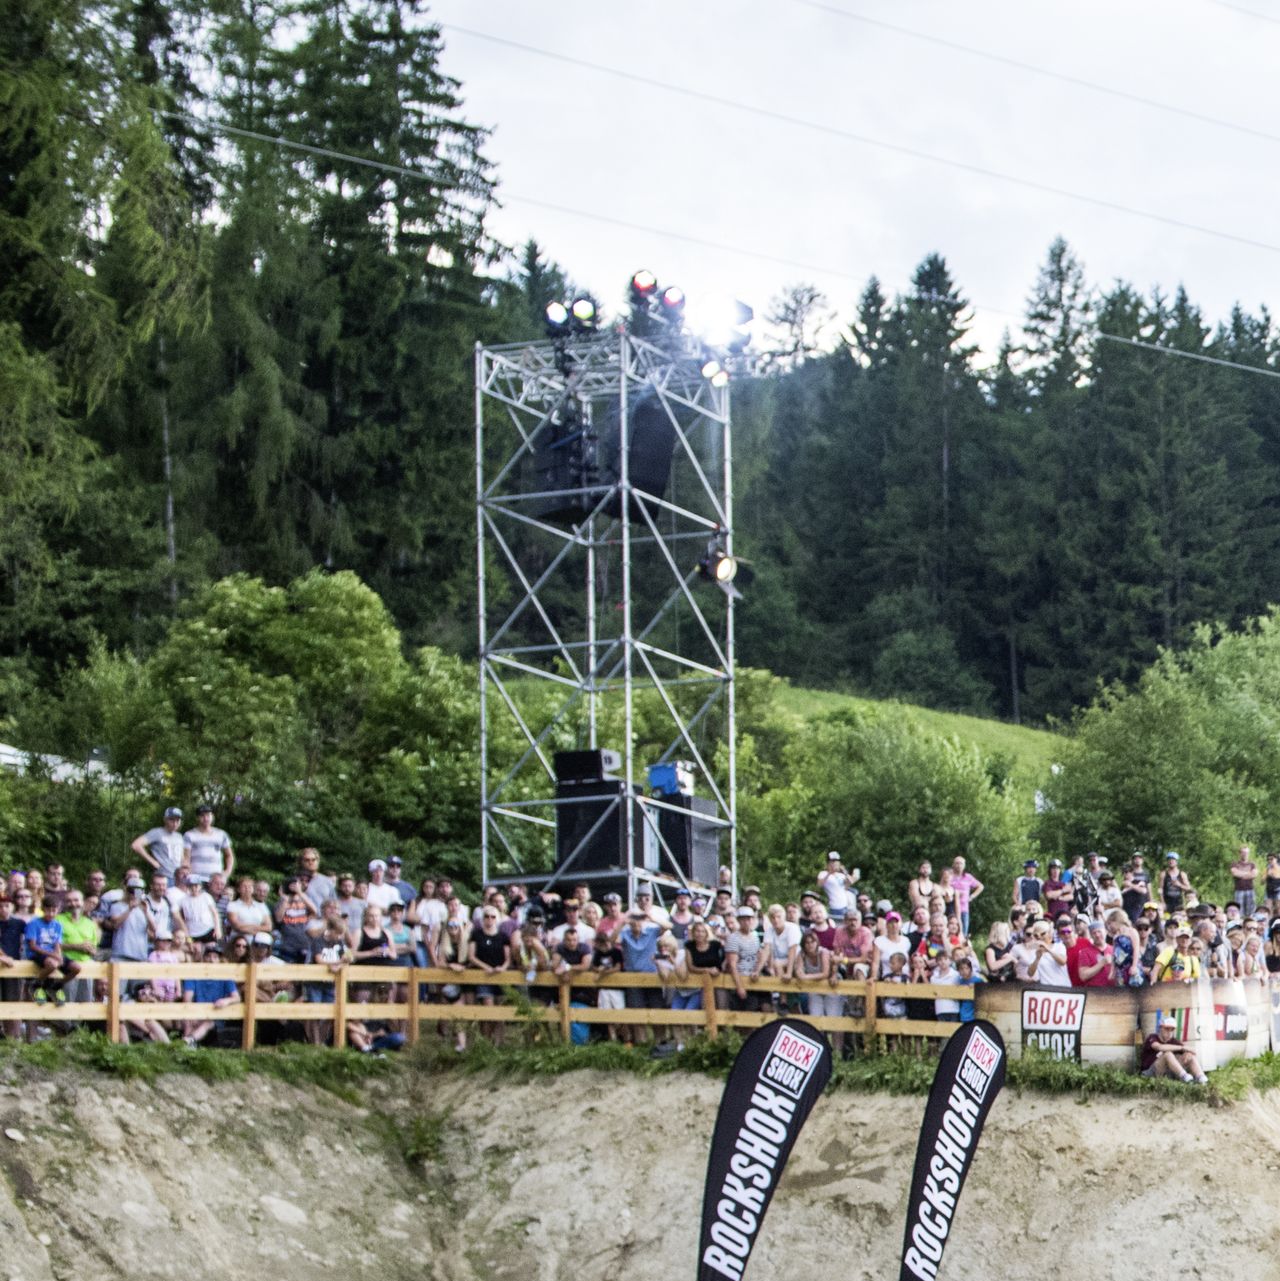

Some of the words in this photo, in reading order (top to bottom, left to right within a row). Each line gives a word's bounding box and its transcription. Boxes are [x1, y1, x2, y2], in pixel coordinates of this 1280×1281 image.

[1028, 1001, 1078, 1026] ROCK
[780, 1035, 814, 1065] ROCK
[969, 1034, 996, 1070] ROCK
[766, 1057, 805, 1092] SHOX
[960, 1058, 988, 1094] SHOX
